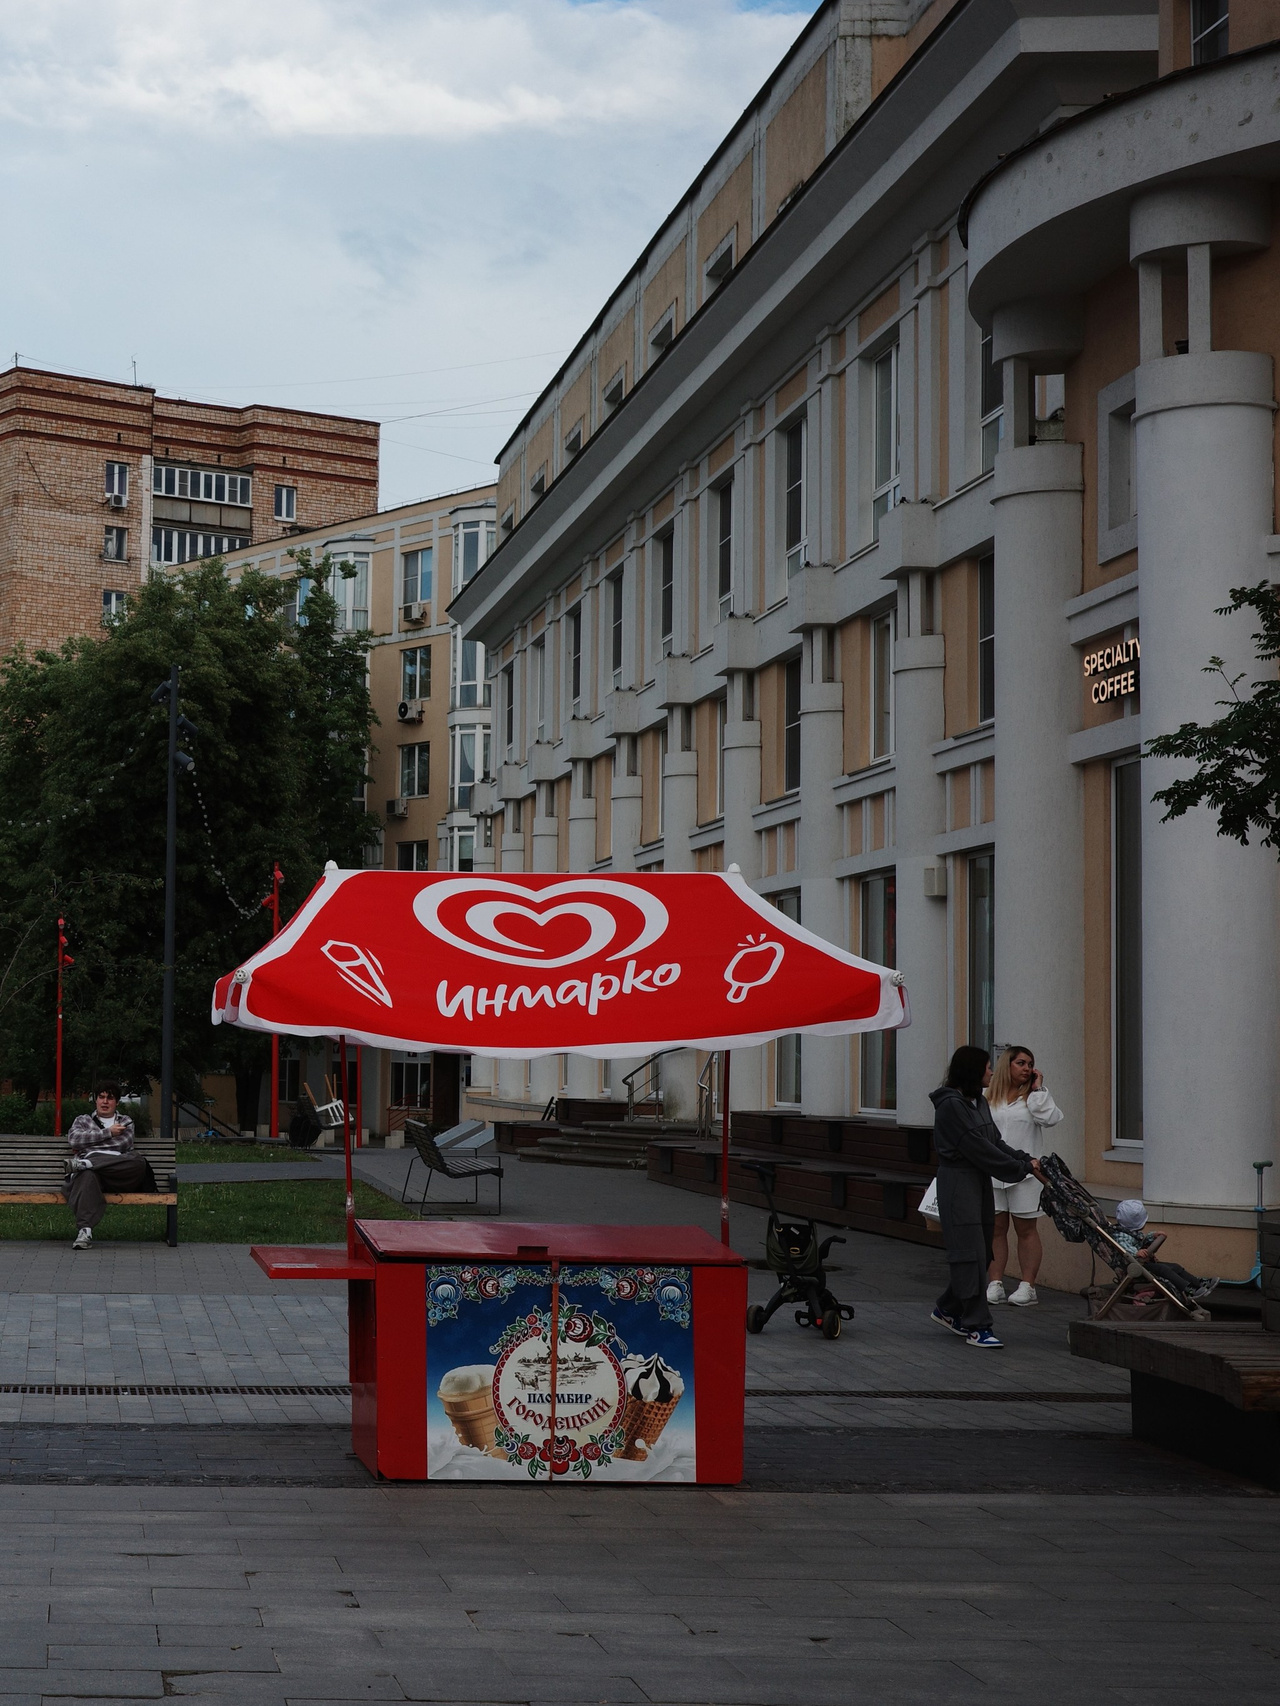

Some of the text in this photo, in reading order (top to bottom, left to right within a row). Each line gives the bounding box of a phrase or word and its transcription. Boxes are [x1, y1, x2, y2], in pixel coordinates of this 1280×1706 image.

[1083, 637, 1141, 677] SPECIALTY
[1091, 670, 1135, 704] COFFEE
[506, 1396, 612, 1432] ГОРОДЕЦКИЙ
[527, 1393, 592, 1404] ПЛОМБИР
